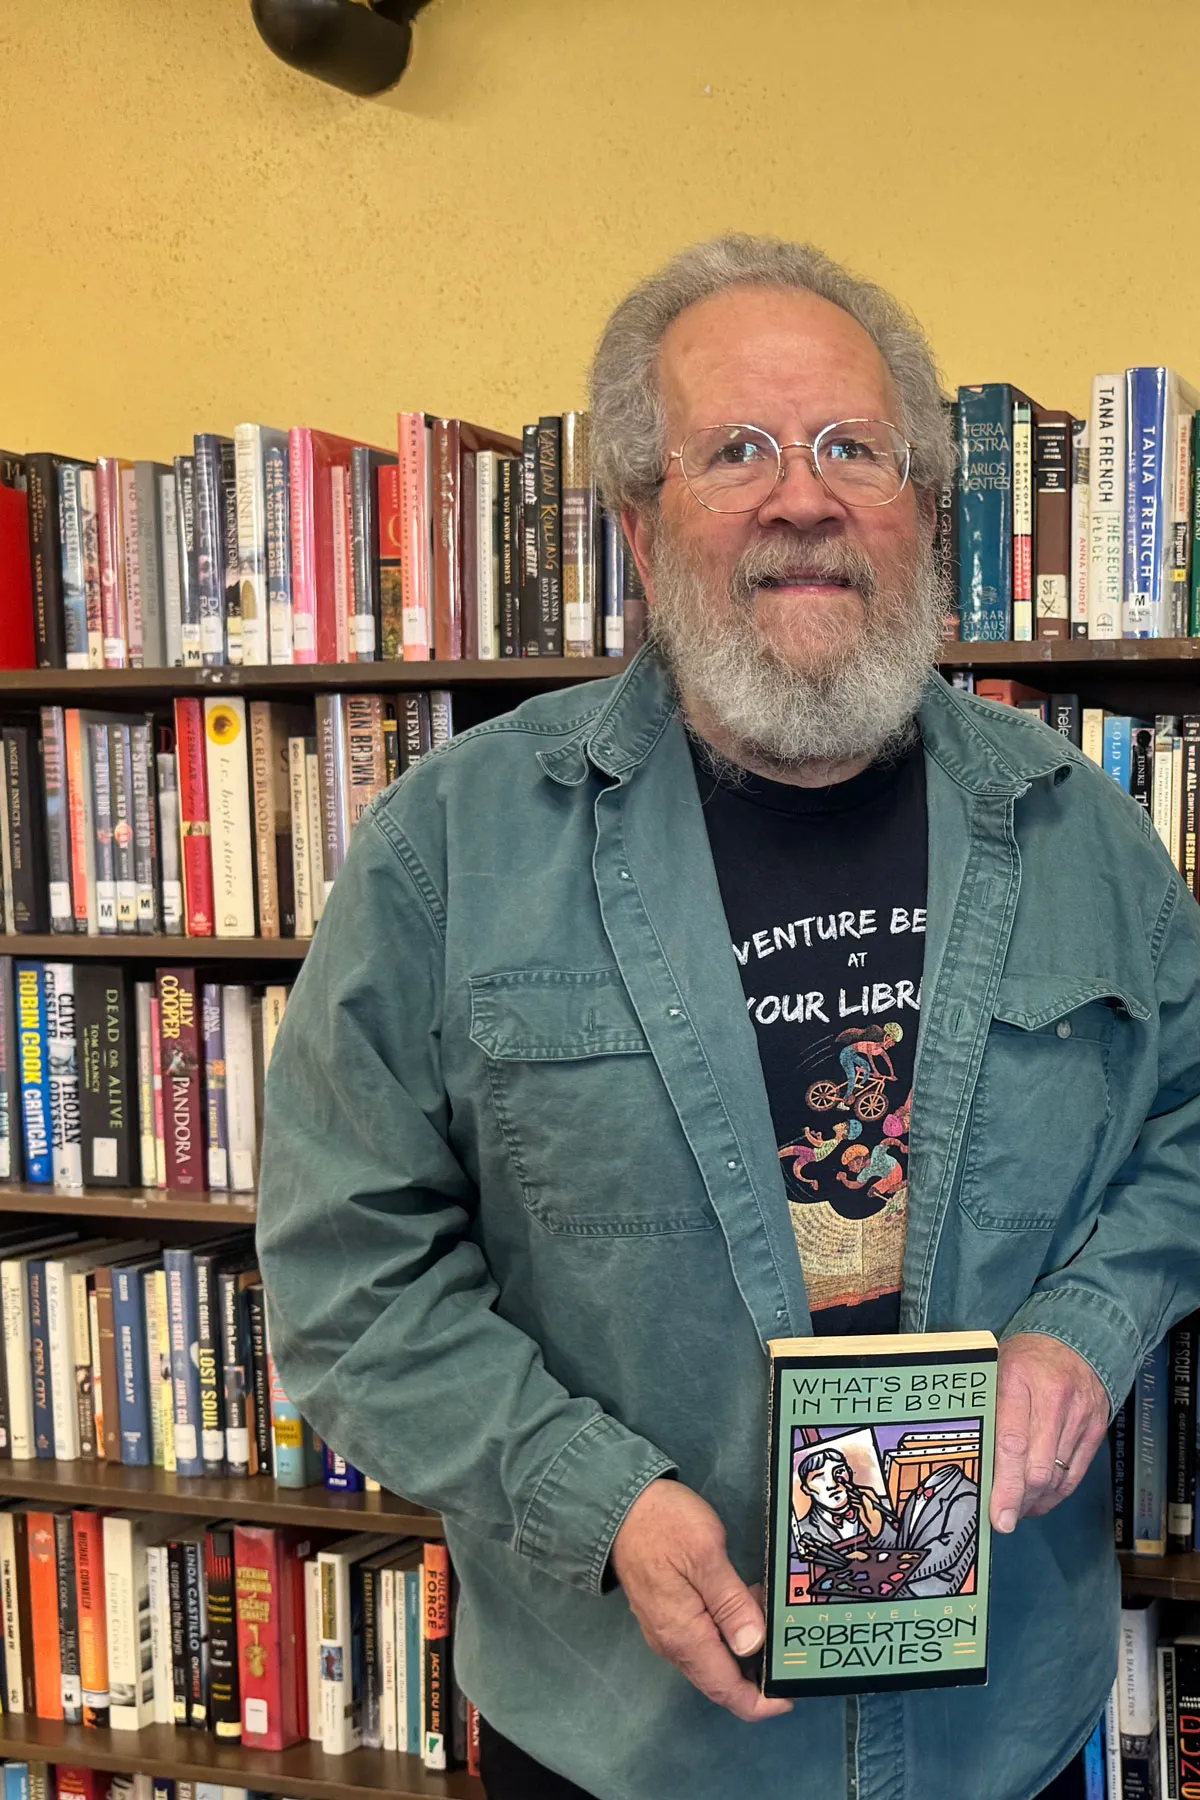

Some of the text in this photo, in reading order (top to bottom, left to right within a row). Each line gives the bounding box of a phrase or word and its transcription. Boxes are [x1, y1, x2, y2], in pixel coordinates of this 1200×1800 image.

[503, 462, 511, 494] BEFORE
[1098, 387, 1114, 503] TANA FRENCH
[539, 428, 558, 571] BABYLON ROLLING
[1140, 426, 1155, 577] TANA FRENCH
[504, 544, 512, 585] KINDNESS
[1107, 515, 1120, 603] THE SECRET
[542, 578, 550, 622] BOYDEN
[551, 578, 559, 622] AMANDA
[349, 701, 375, 786] DAN BROWN
[406, 699, 421, 751] STEVE
[253, 719, 268, 833] SACRED BLOOD
[323, 718, 337, 850] SKELETON JUSTICE
[848, 952, 868, 968] AT
[160, 974, 180, 1039] COOPER
[839, 977, 922, 1017] LIBR
[19, 970, 48, 1160] ROBIN COOK CRITICAL
[105, 988, 123, 1129] DEAD OR ALIVE
[172, 1076, 192, 1164] PANDORA
[199, 1348, 217, 1431] LOST SOUL
[792, 1391, 987, 1415] IN THE BONE
[793, 1372, 987, 1394] WHAT'S BRED
[1174, 1332, 1190, 1405] RESCUE ME
[186, 1546, 200, 1651] LINDA CASTILLO
[783, 1615, 977, 1647] ROBERTSON
[785, 1604, 977, 1623] A NOVEL BY
[820, 1642, 943, 1668] DAVIES
